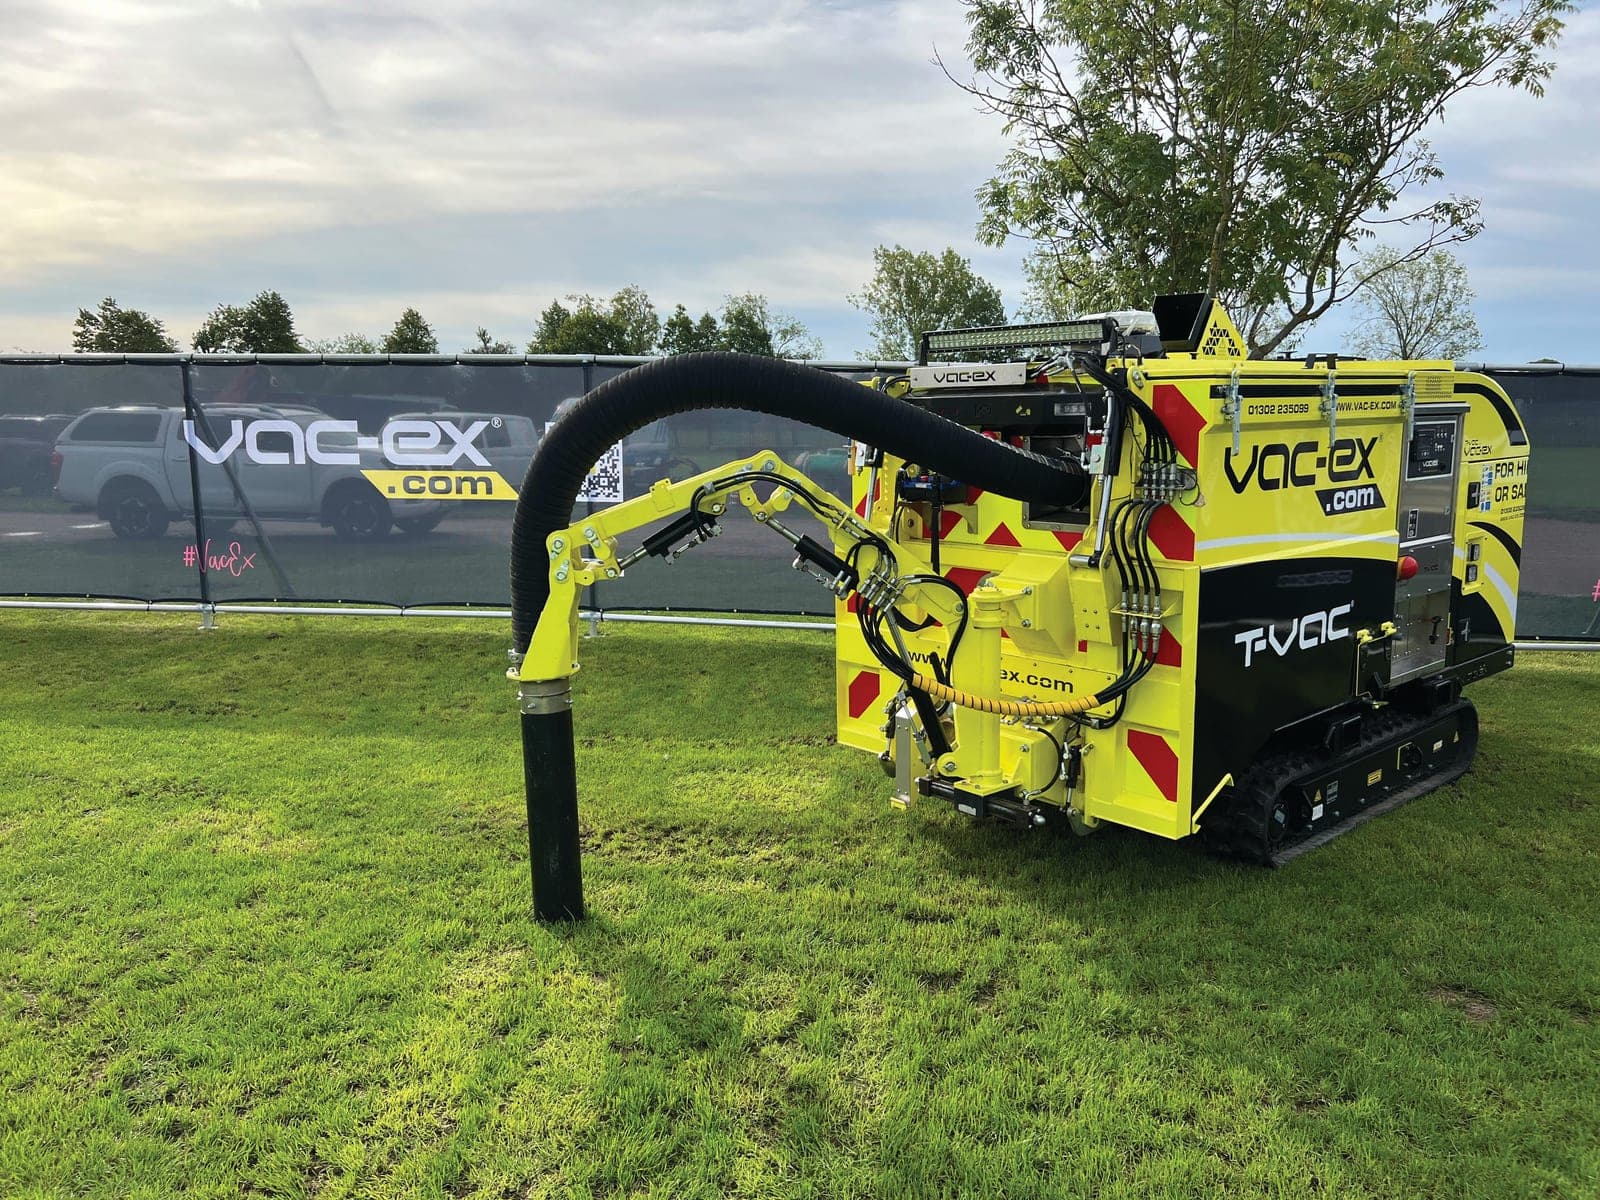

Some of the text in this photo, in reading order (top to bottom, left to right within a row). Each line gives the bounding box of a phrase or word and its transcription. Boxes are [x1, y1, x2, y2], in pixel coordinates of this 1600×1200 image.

[1248, 403, 1309, 415] 01302 235099
[1494, 462, 1514, 479] FOR
[387, 475, 494, 496] .com
[1495, 486, 1509, 502] OR
[1325, 486, 1375, 512] .com
[183, 538, 257, 577] #VacEx
